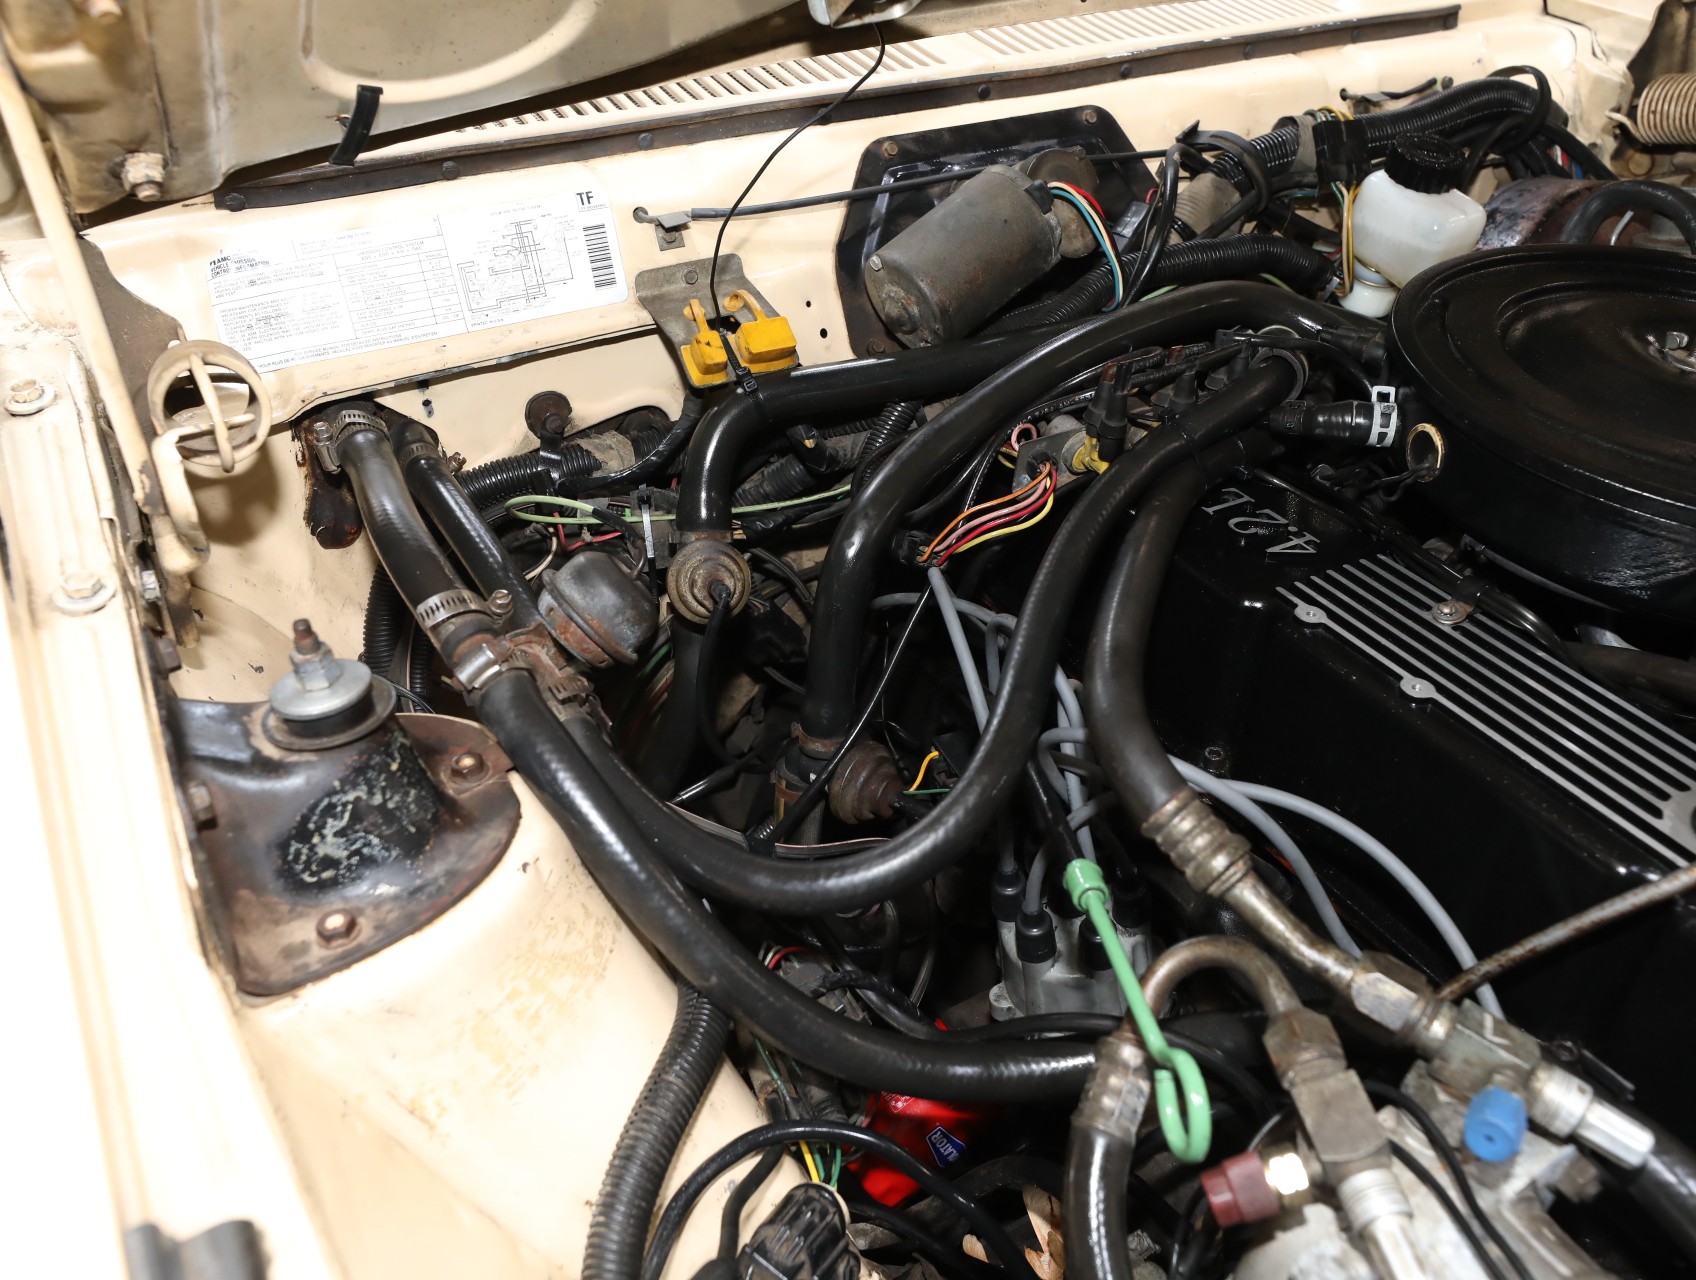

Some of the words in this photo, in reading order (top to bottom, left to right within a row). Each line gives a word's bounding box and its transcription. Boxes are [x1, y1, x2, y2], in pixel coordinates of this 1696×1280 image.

[576, 191, 594, 206] TF
[211, 262, 230, 273] VEHICLE
[217, 256, 232, 265] AMC
[1201, 488, 1321, 554] 4.2L
[931, 1131, 959, 1162] LATOR
